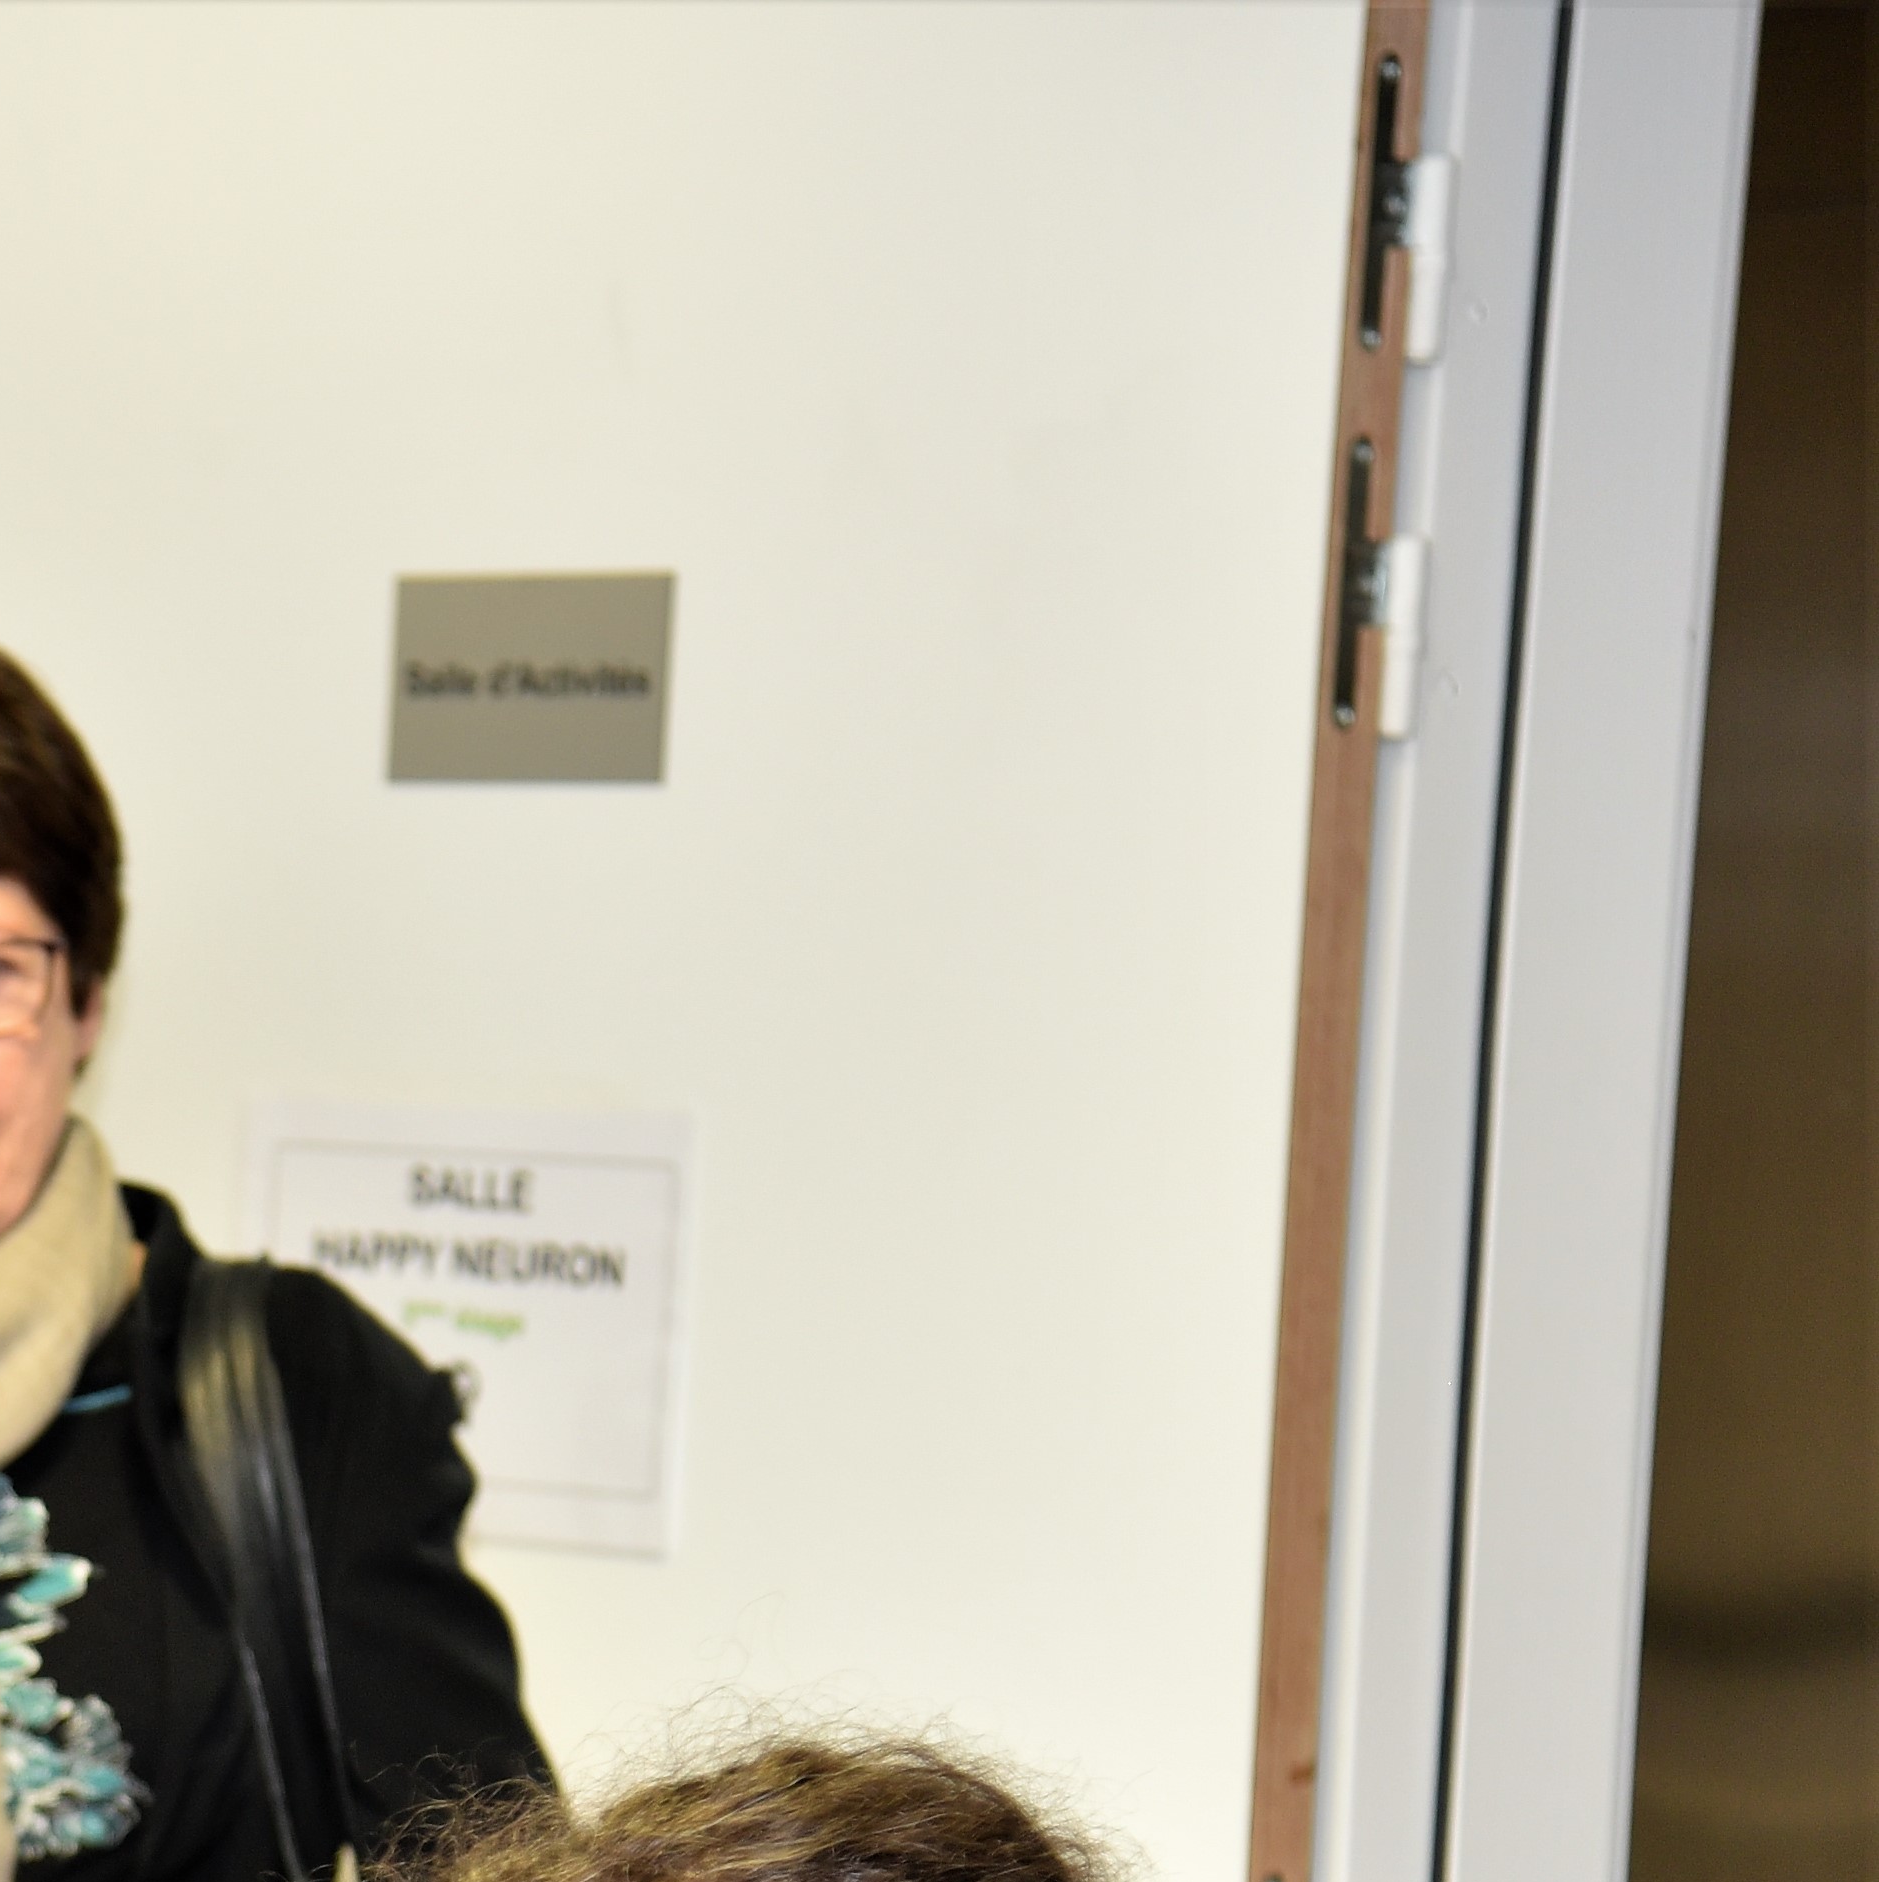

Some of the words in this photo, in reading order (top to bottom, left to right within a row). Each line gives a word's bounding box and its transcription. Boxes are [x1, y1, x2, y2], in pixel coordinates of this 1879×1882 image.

[408, 1162, 533, 1214] SALLE
[312, 1230, 437, 1278] HAPPY
[451, 1236, 626, 1289] NEURON
